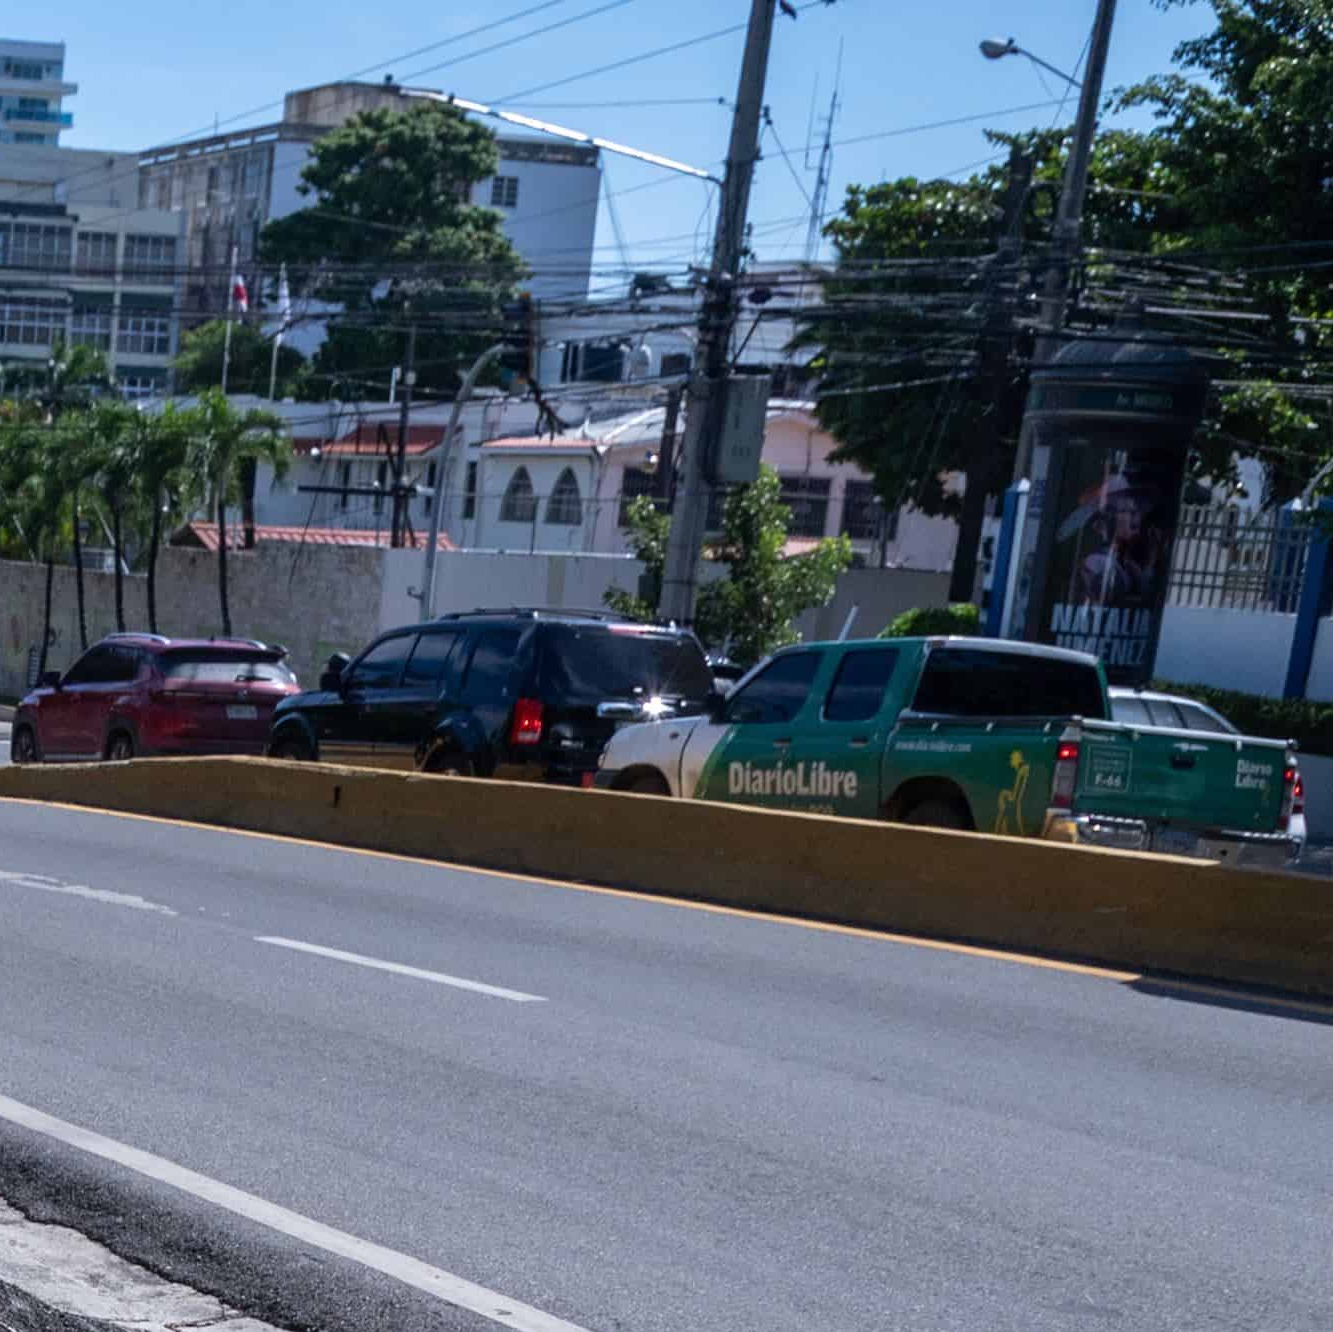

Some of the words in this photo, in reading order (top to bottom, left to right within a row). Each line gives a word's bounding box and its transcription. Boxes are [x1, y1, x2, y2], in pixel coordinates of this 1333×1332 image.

[1236, 759, 1273, 776] Diario
[728, 760, 858, 798] DiarioLibre
[1235, 773, 1267, 790] Libre
